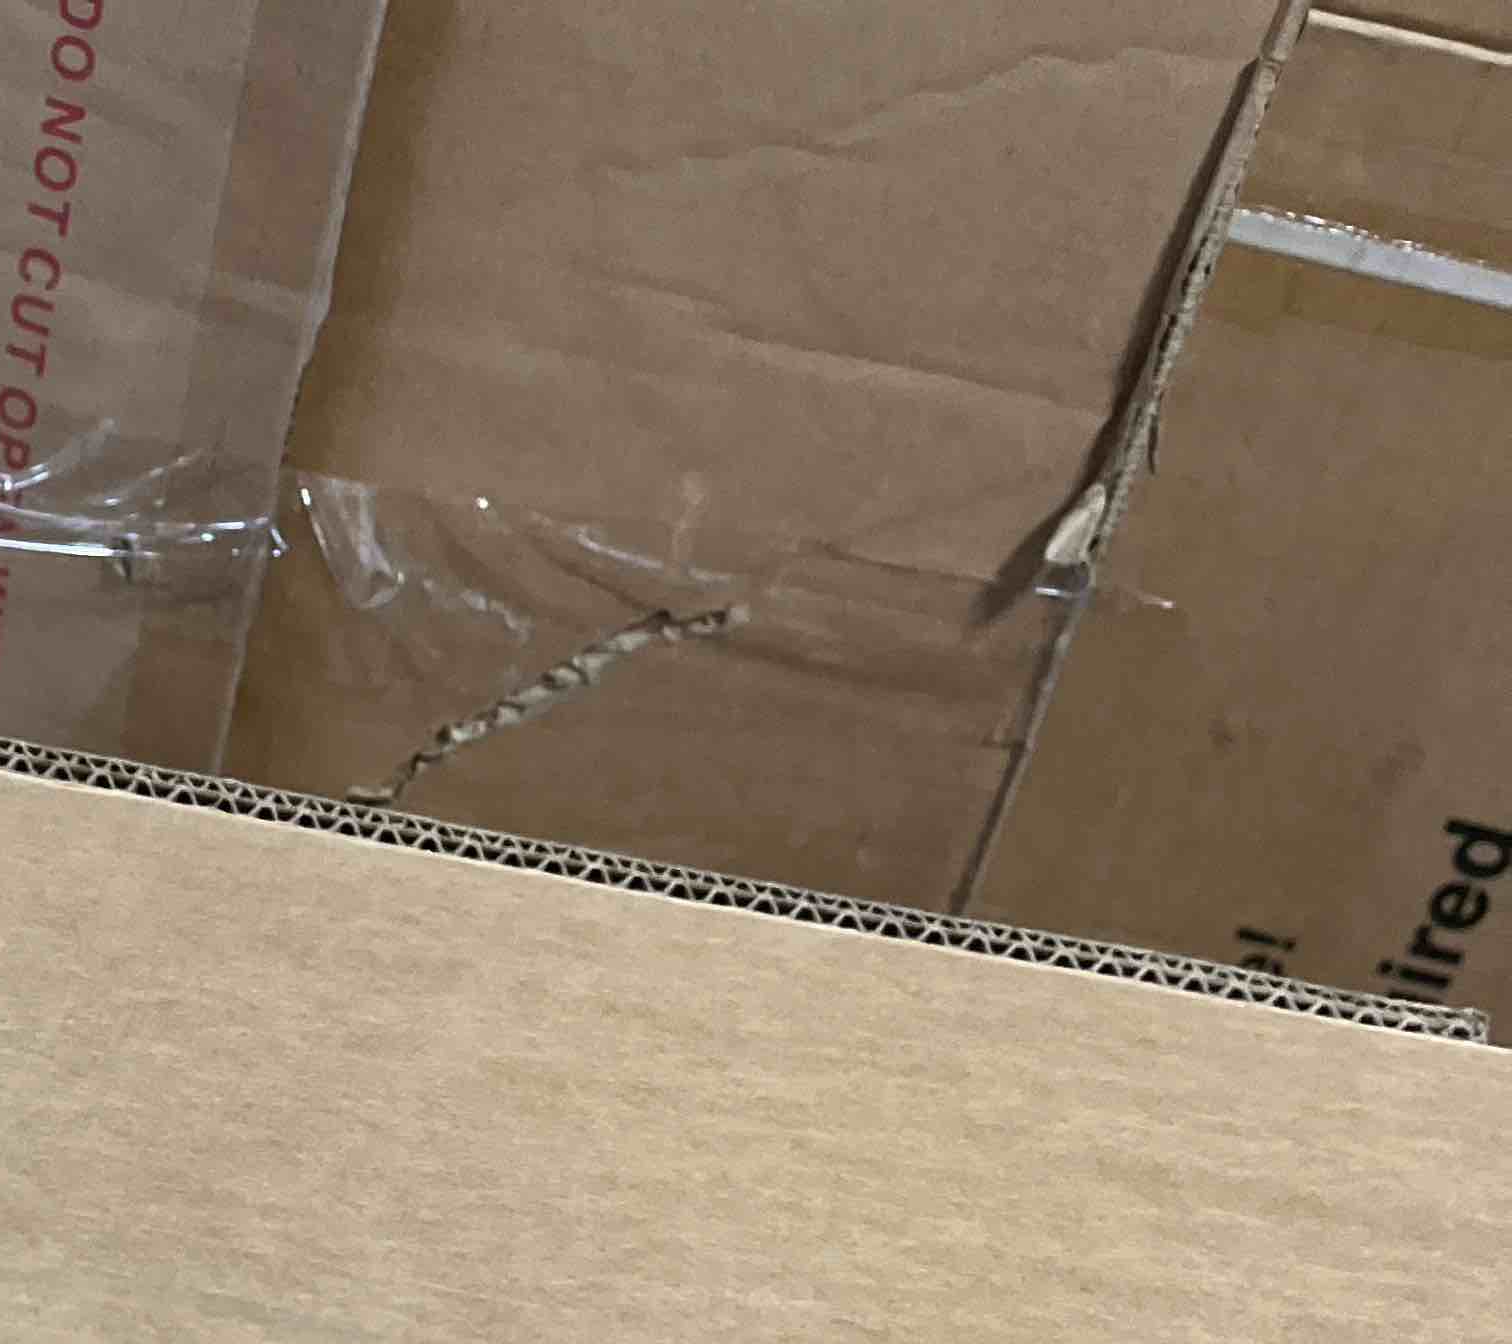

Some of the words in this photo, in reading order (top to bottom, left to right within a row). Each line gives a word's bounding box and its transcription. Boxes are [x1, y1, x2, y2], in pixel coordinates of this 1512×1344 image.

[50, 0, 104, 81] DO
[27, 96, 86, 237] NOT
[5, 248, 61, 378] CUT
[1376, 818, 1512, 1004] ired
